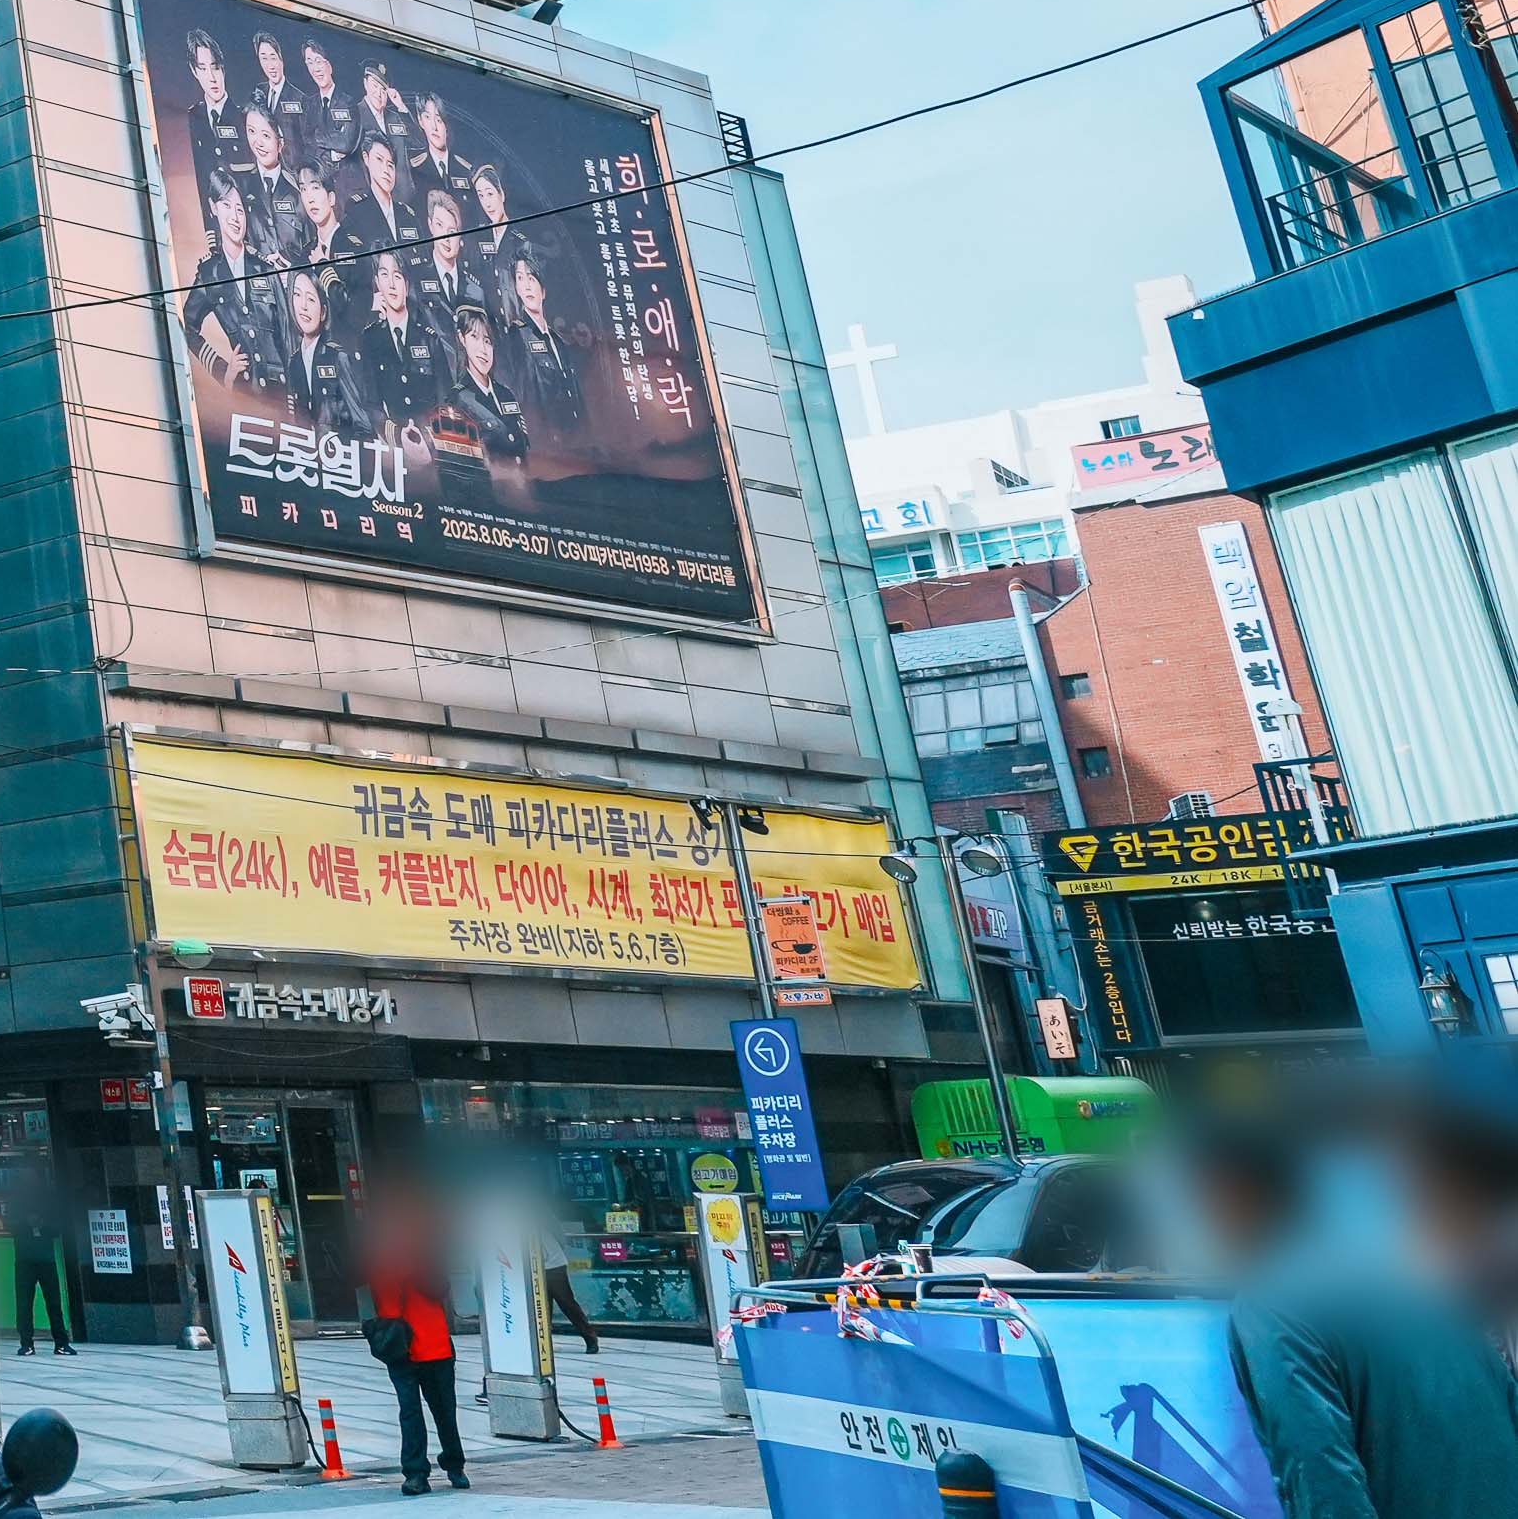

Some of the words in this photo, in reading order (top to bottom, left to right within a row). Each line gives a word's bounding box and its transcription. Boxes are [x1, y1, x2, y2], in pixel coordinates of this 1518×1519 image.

[226, 413, 408, 502] 트롯열차
[372, 499, 412, 518] Season
[413, 502, 423, 519] 2
[861, 500, 931, 532] 교회
[440, 517, 549, 556] 2025.8.06~9.07
[558, 538, 668, 574] CGV피카디리1958
[677, 559, 736, 586] 피카디리홀
[354, 784, 432, 843] 귀금속
[444, 791, 495, 848] 도매
[505, 796, 675, 858] 피카디리플러스
[684, 810, 738, 866] 상가
[163, 827, 299, 899] 순금(24k),
[308, 845, 372, 905] 예물,
[379, 852, 490, 911] 커플반지,
[497, 861, 577, 920] 다이아,
[587, 866, 642, 924] 시계,
[649, 871, 713, 928] 최저가
[853, 891, 895, 942] 매입
[1069, 880, 1113, 892] [서울본사]
[1171, 874, 1201, 884] 24K
[1222, 871, 1251, 880] 18K
[782, 916, 809, 927] COFFEE
[990, 908, 1007, 940] ZIP
[1173, 920, 1243, 940] 신뢰받는
[449, 919, 511, 953] 주차장
[518, 925, 605, 961] 완비(지하
[612, 932, 686, 966] 5,6,7층)
[776, 955, 805, 966] 피카디리
[808, 956, 818, 964] 2F
[1083, 901, 1112, 967] 금거래소는
[1104, 973, 1132, 1043] 2층입니다
[191, 983, 220, 996] 피카디리
[193, 1001, 223, 1013] 플러스
[229, 982, 397, 1024] 귀금속도매상가
[751, 1095, 801, 1111] 피카디리
[755, 1114, 794, 1129] 플러스
[758, 1132, 796, 1147] 주차장
[693, 1169, 736, 1180] 최고가매입
[841, 1411, 886, 1454] 안전
